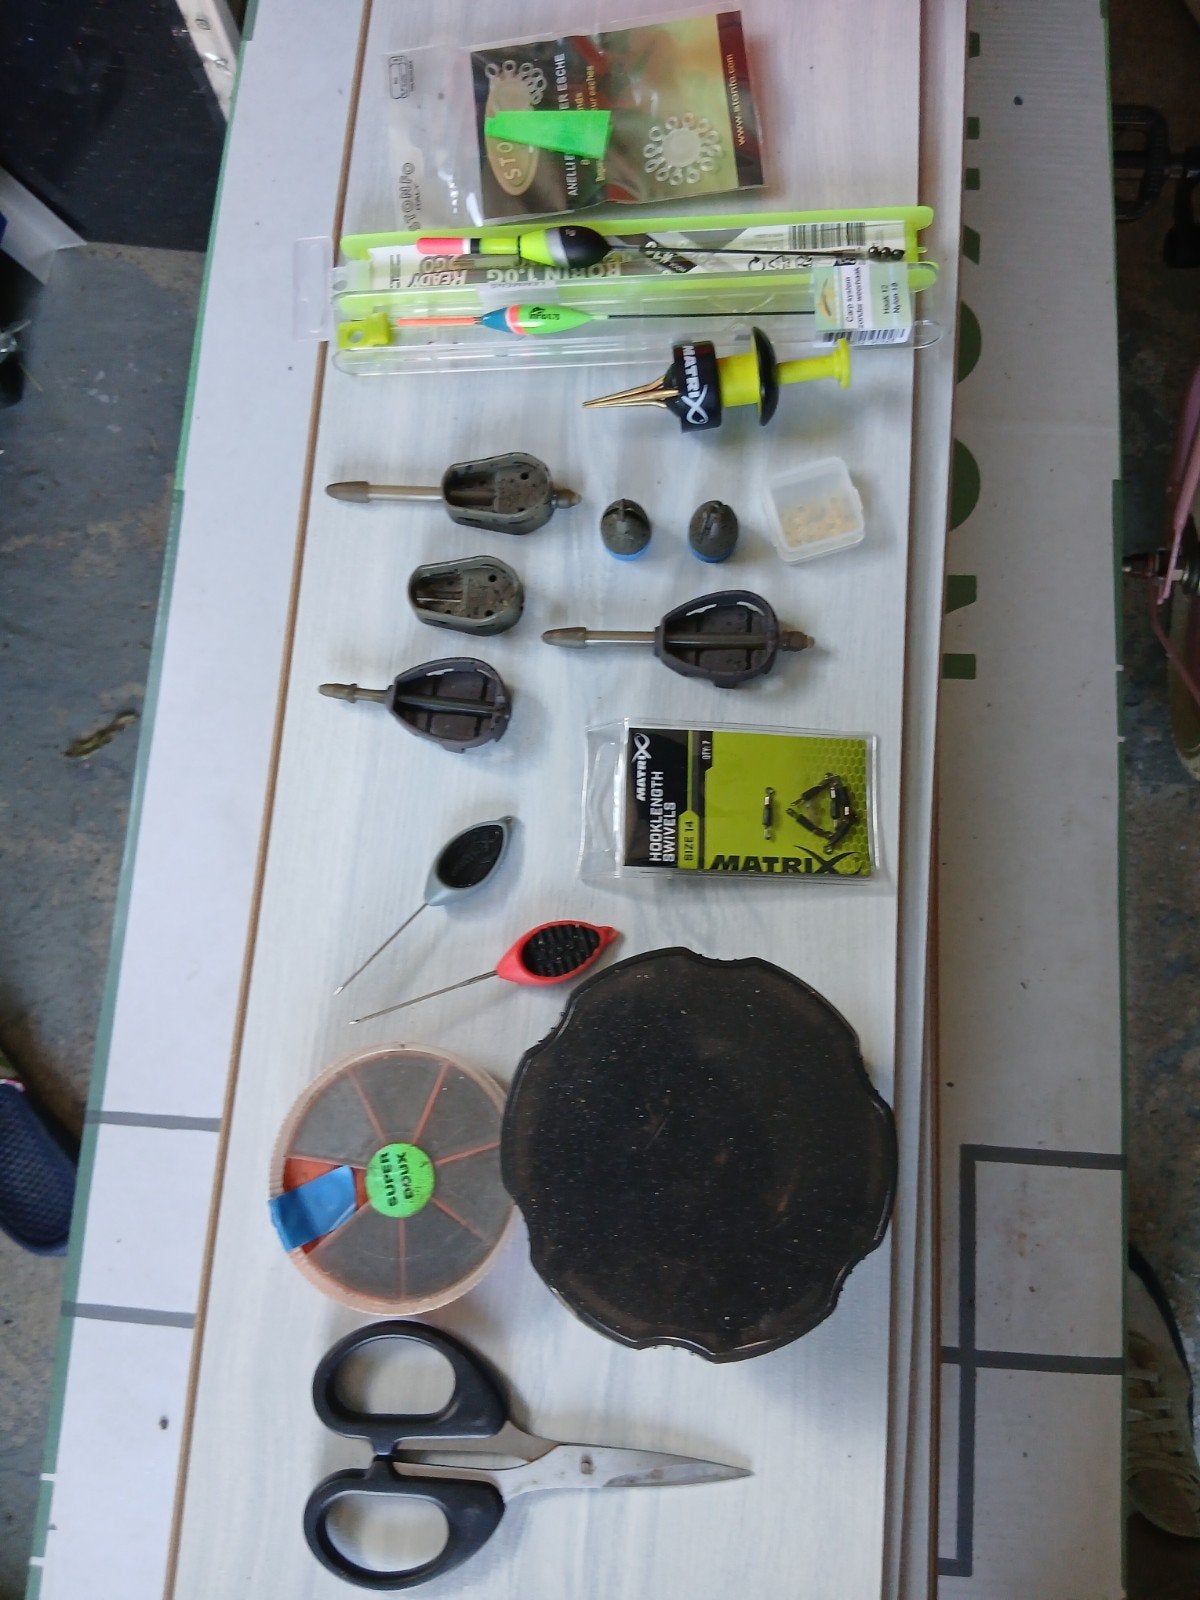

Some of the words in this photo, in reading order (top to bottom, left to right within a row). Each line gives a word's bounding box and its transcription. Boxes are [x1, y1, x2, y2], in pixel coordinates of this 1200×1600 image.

[554, 53, 568, 92] ESCHE
[557, 93, 570, 110] ER
[726, 54, 746, 146] www.stonfo.com
[565, 162, 579, 197] ANELLI
[408, 269, 468, 288] READY
[844, 276, 853, 302] system
[846, 304, 854, 323] Carp
[680, 345, 709, 425] MATRIX
[631, 732, 652, 801] MATRIX
[649, 771, 664, 862] HOOKLENGTH
[662, 802, 677, 862] SWIVELS
[684, 820, 695, 831] 14
[684, 834, 695, 861] SIZE
[709, 845, 863, 875] MATRIX
[380, 1152, 397, 1207] SUPER
[397, 1152, 414, 1199] DOUX
